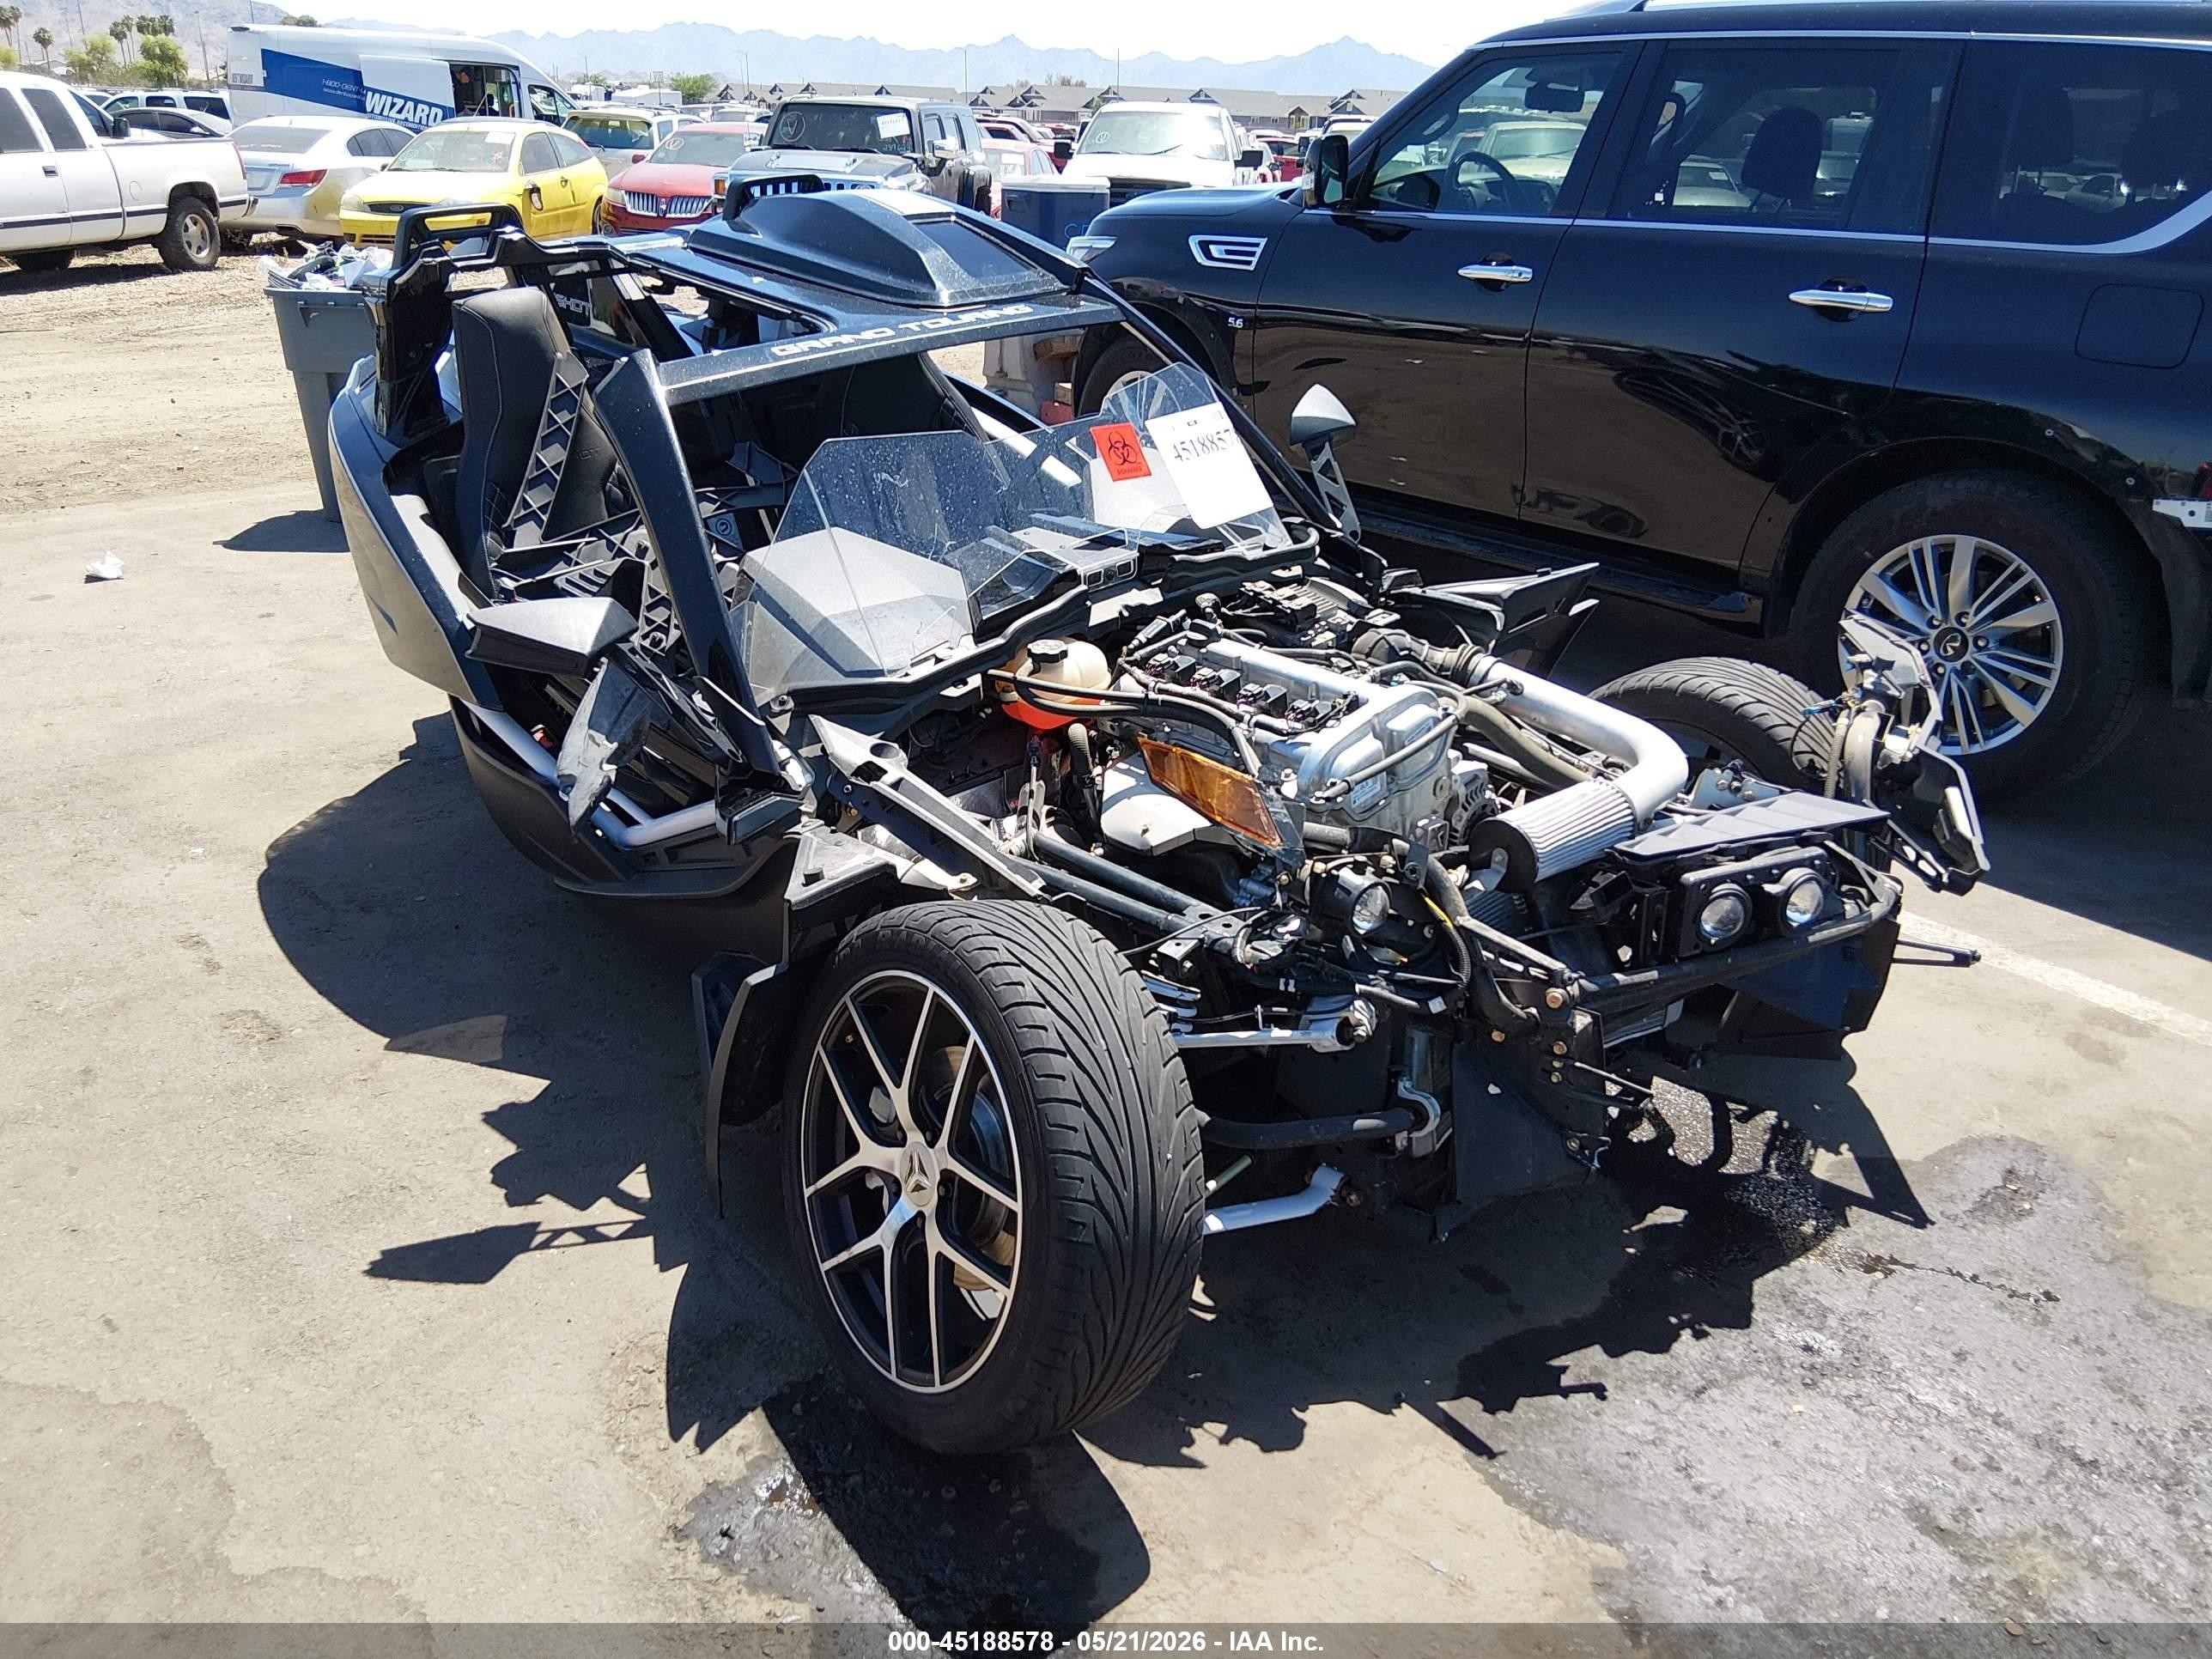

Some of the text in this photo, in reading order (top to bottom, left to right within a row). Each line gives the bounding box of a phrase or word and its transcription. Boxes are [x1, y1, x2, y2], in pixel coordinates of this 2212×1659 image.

[365, 91, 443, 127] WIZARD
[770, 304, 1033, 356] GRAND TOURING
[1173, 428, 1240, 462] 4518857
